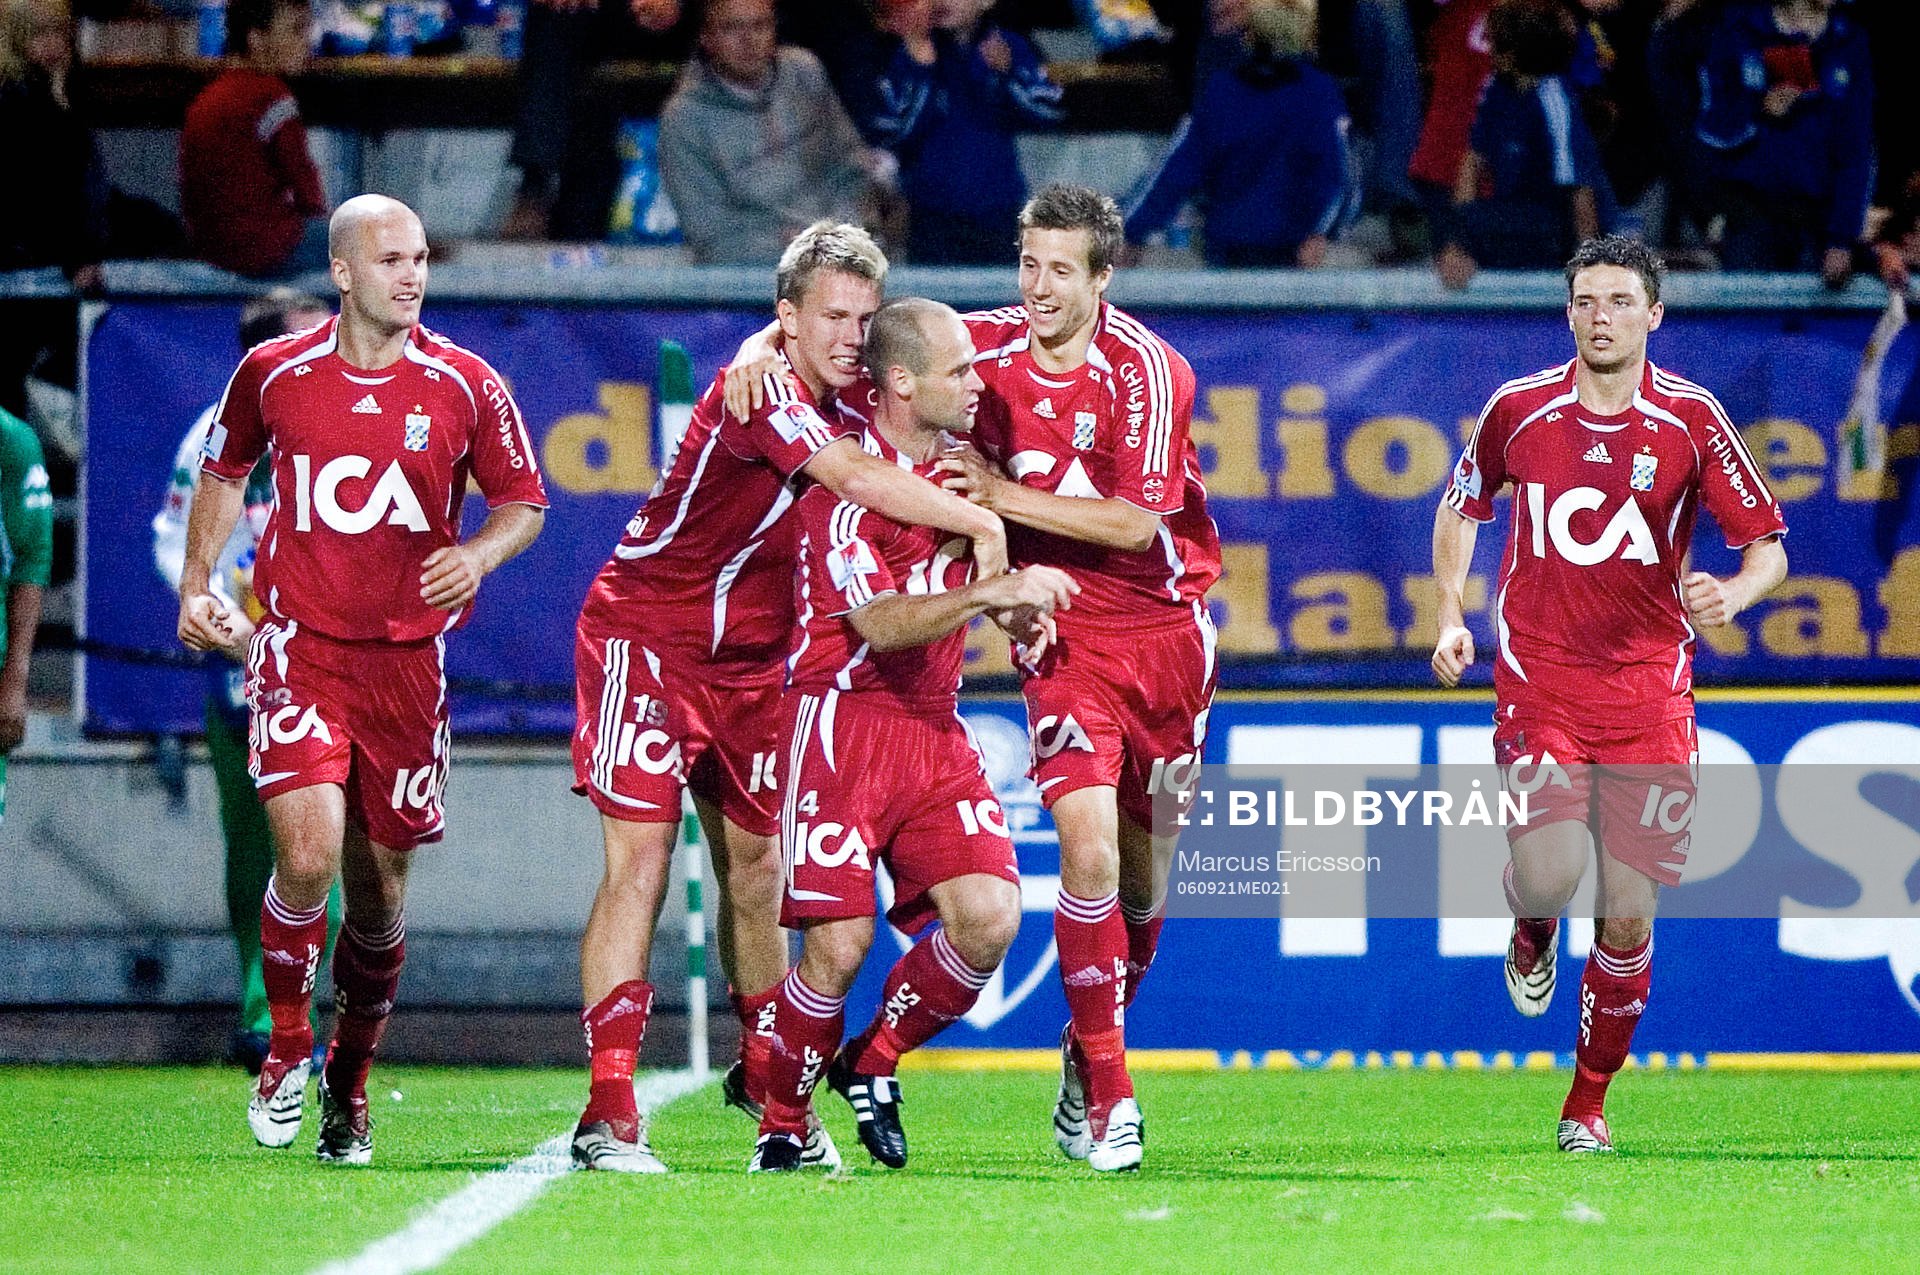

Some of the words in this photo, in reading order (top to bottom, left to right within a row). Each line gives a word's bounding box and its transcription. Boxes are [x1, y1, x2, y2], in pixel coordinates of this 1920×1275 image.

[293, 364, 312, 377] ICA
[424, 367, 441, 382] ICA
[1119, 362, 1148, 449] CHILDHOOD
[1545, 410, 1563, 424] ICA
[1643, 418, 1659, 433] ICA
[293, 454, 431, 535] ICA
[1526, 482, 1660, 567] ICA
[258, 703, 333, 752] ICA
[633, 693, 668, 726] 19
[797, 790, 820, 817] 4
[794, 821, 872, 870] ICA
[885, 982, 922, 1029] SKF
[1114, 956, 1127, 1026] SKF
[1580, 983, 1597, 1046] SKF
[797, 1046, 823, 1096] SKF
